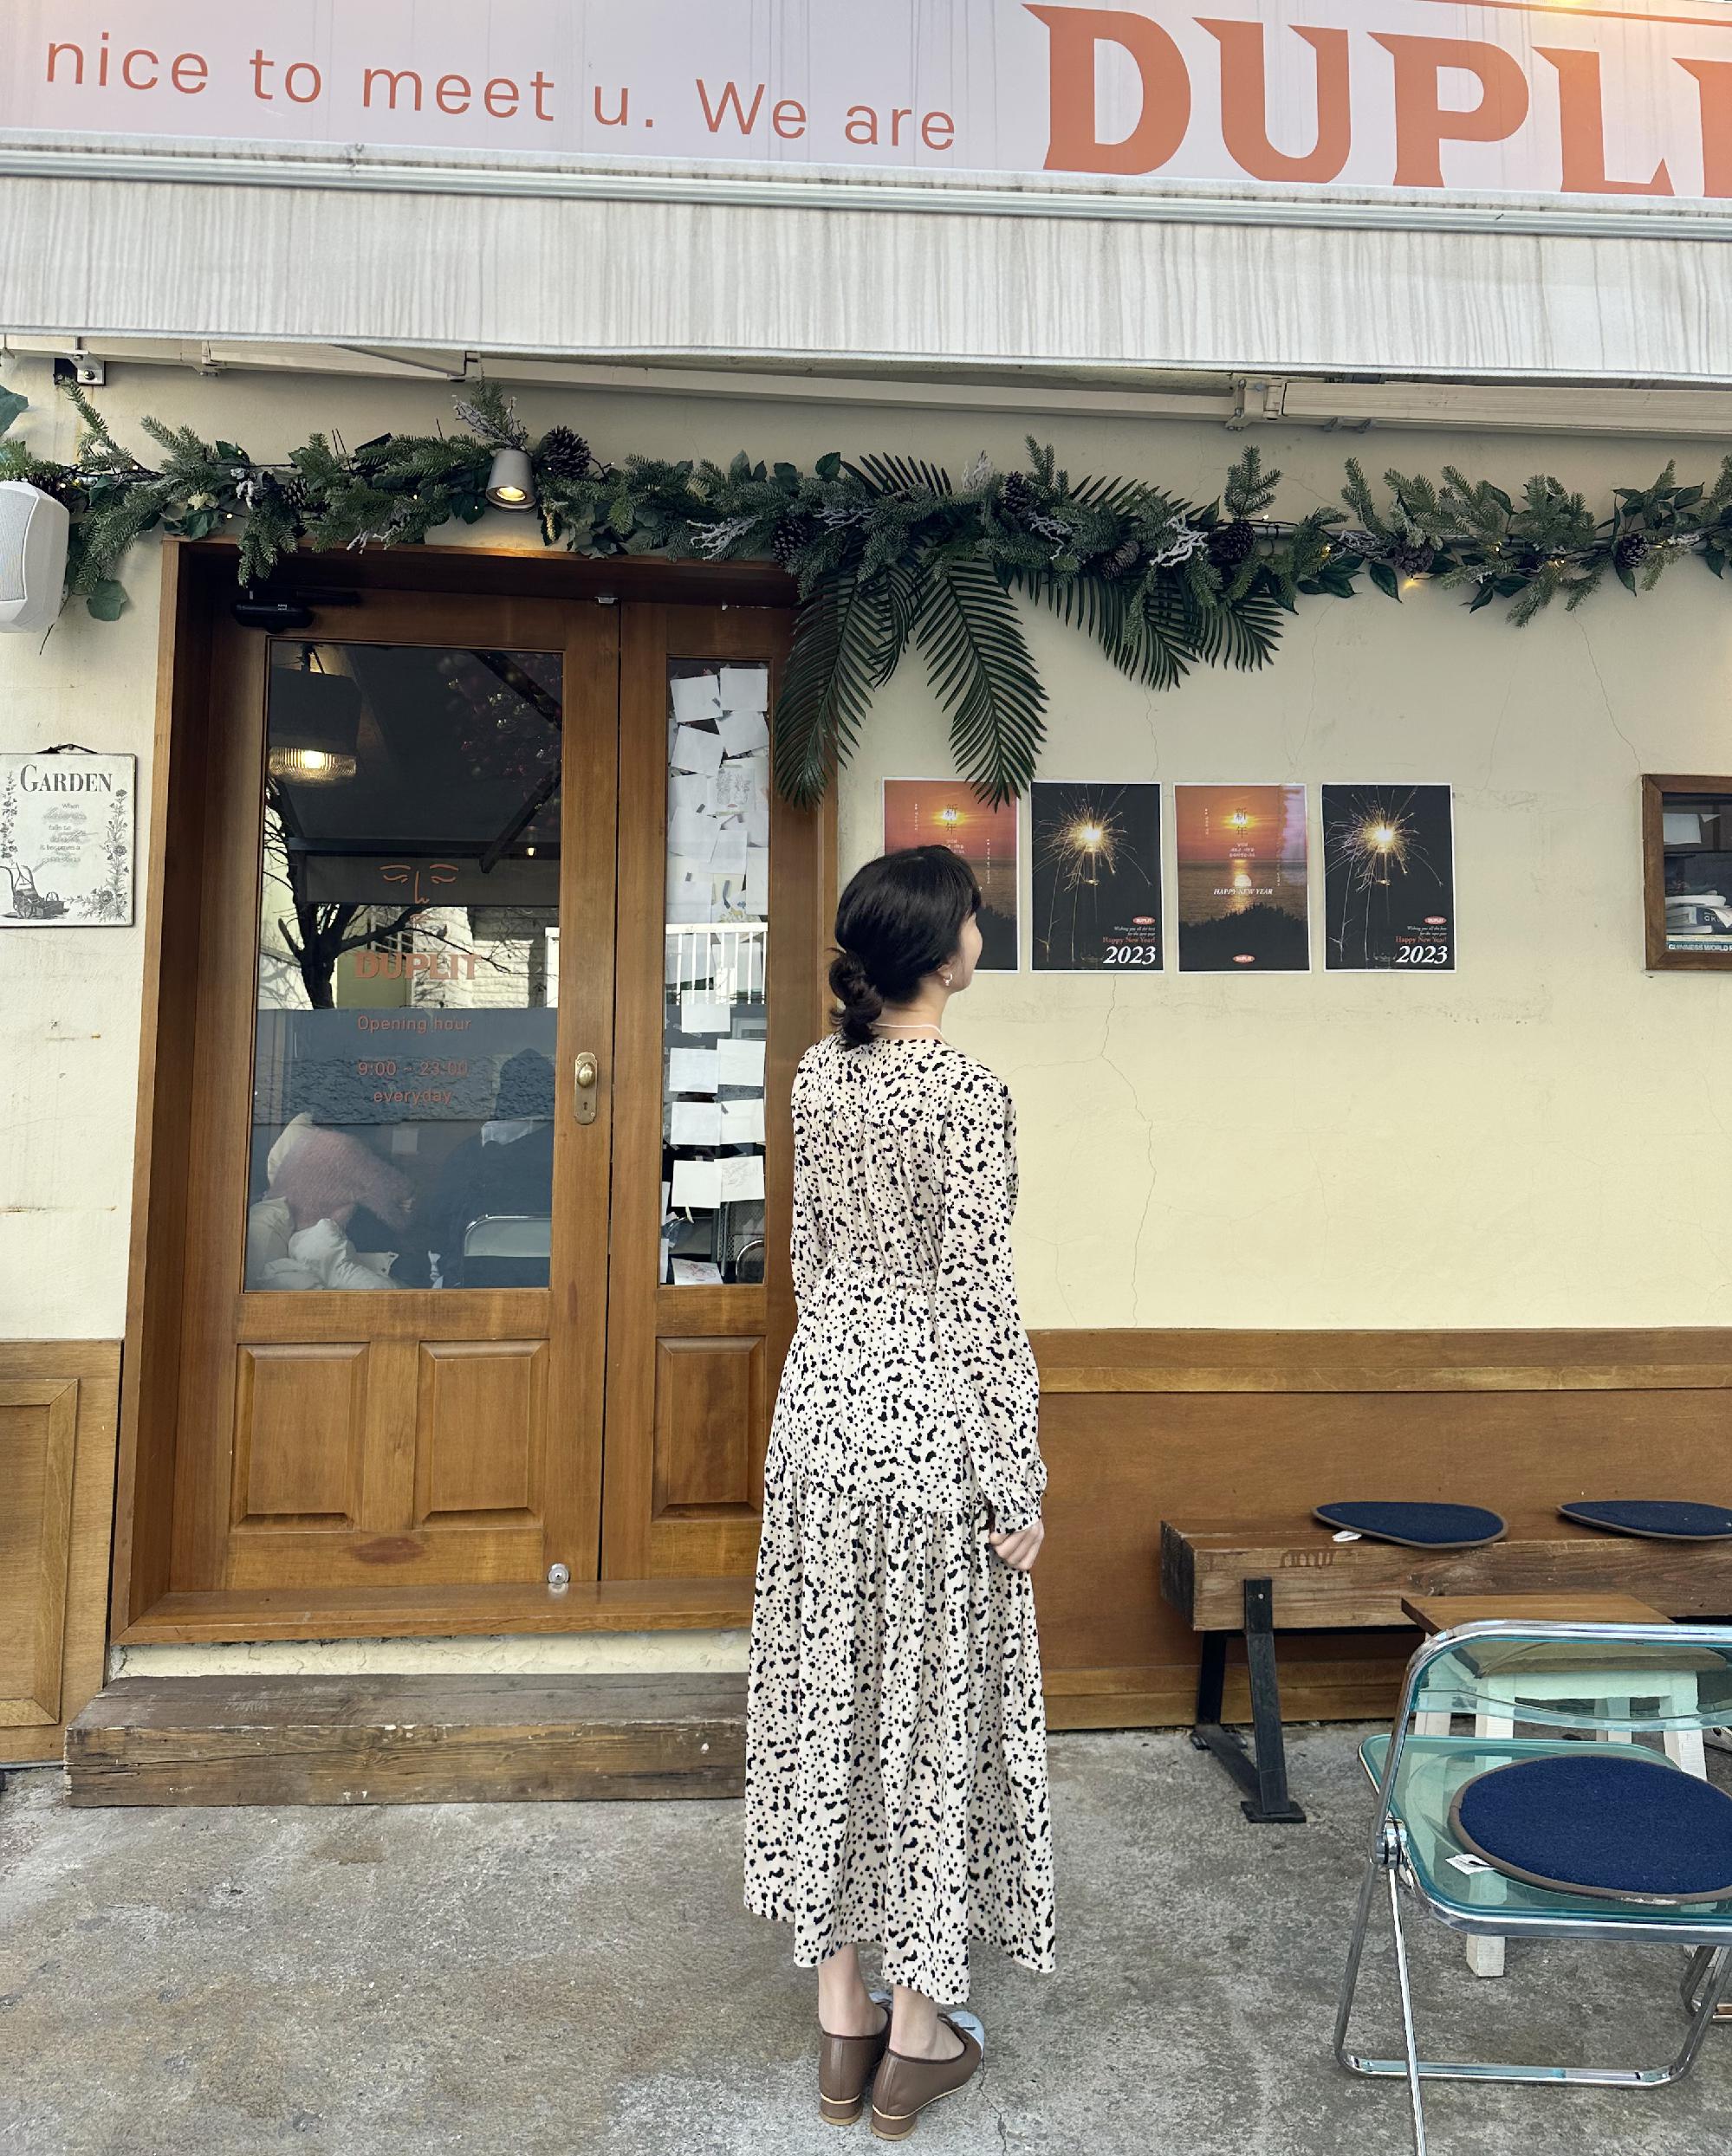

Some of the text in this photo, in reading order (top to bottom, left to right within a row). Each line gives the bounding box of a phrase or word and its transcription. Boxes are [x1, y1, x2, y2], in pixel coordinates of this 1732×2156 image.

[47, 31, 208, 94] nice
[250, 49, 321, 103] to
[364, 69, 554, 120] meet
[595, 87, 655, 127] u.
[697, 80, 805, 139] We
[846, 106, 954, 150] are
[21, 764, 112, 792] GARDEN
[1103, 946, 1156, 965] 2023
[1395, 945, 1448, 964] 2023
[354, 952, 482, 980] DUPLIT
[358, 1016, 471, 1033] Opening hour
[359, 1062, 396, 1076] 9:00
[374, 1090, 451, 1104] everyday
